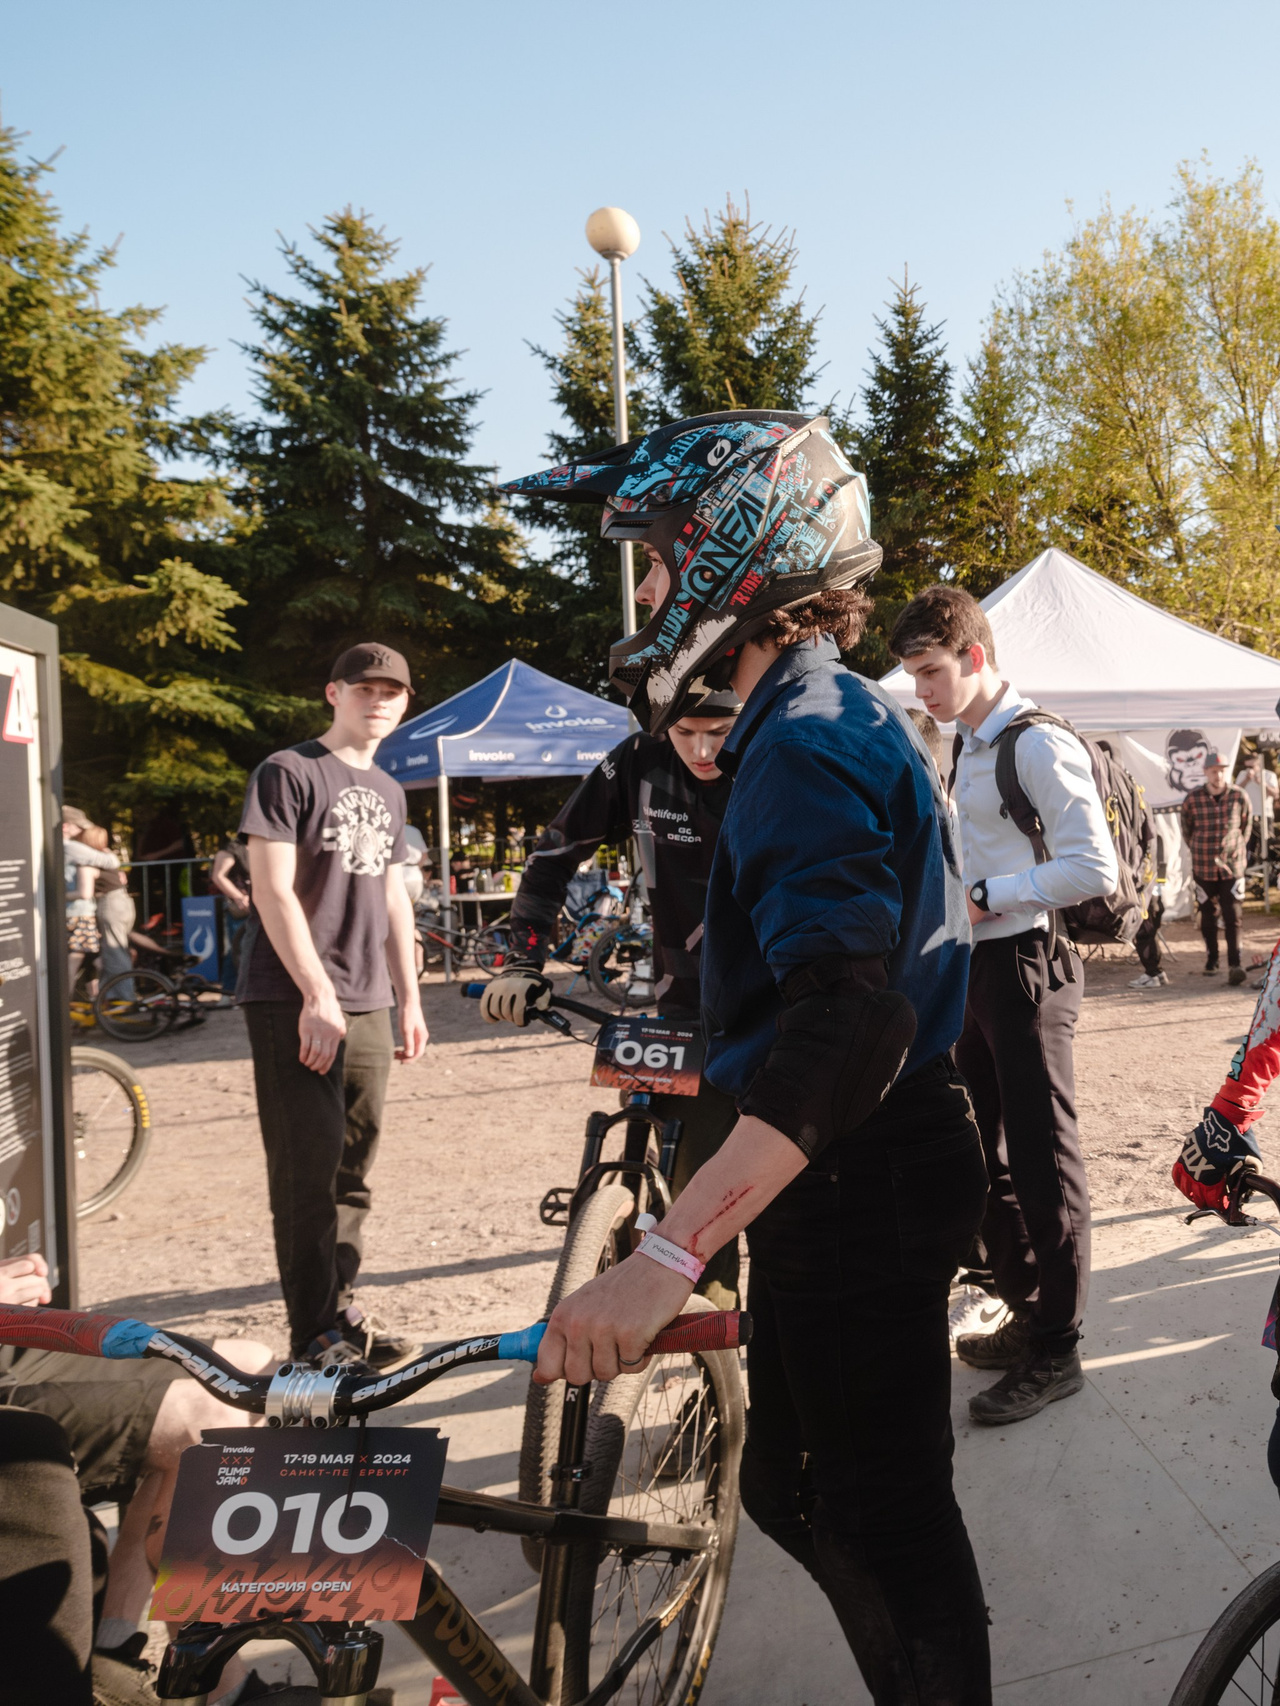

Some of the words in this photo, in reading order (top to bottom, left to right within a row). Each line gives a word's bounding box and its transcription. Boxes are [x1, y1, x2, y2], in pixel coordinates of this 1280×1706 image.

[525, 715, 609, 731] invoke
[469, 749, 515, 762] invoke
[615, 1040, 685, 1071] 061
[1181, 1130, 1216, 1181] FOX
[652, 1243, 689, 1267] УЧАСТНИК
[222, 1445, 255, 1454] invoke
[283, 1454, 317, 1464] 17-19
[319, 1454, 354, 1464] МАЯ
[372, 1454, 412, 1464] 2024
[218, 1467, 251, 1476] PUMP
[279, 1468, 410, 1477] САНКТ-ПЕЕРБУРГ
[211, 1491, 389, 1556] 010
[220, 1581, 307, 1593] КАТЕГОРИЯ
[311, 1581, 352, 1593] OPEN
